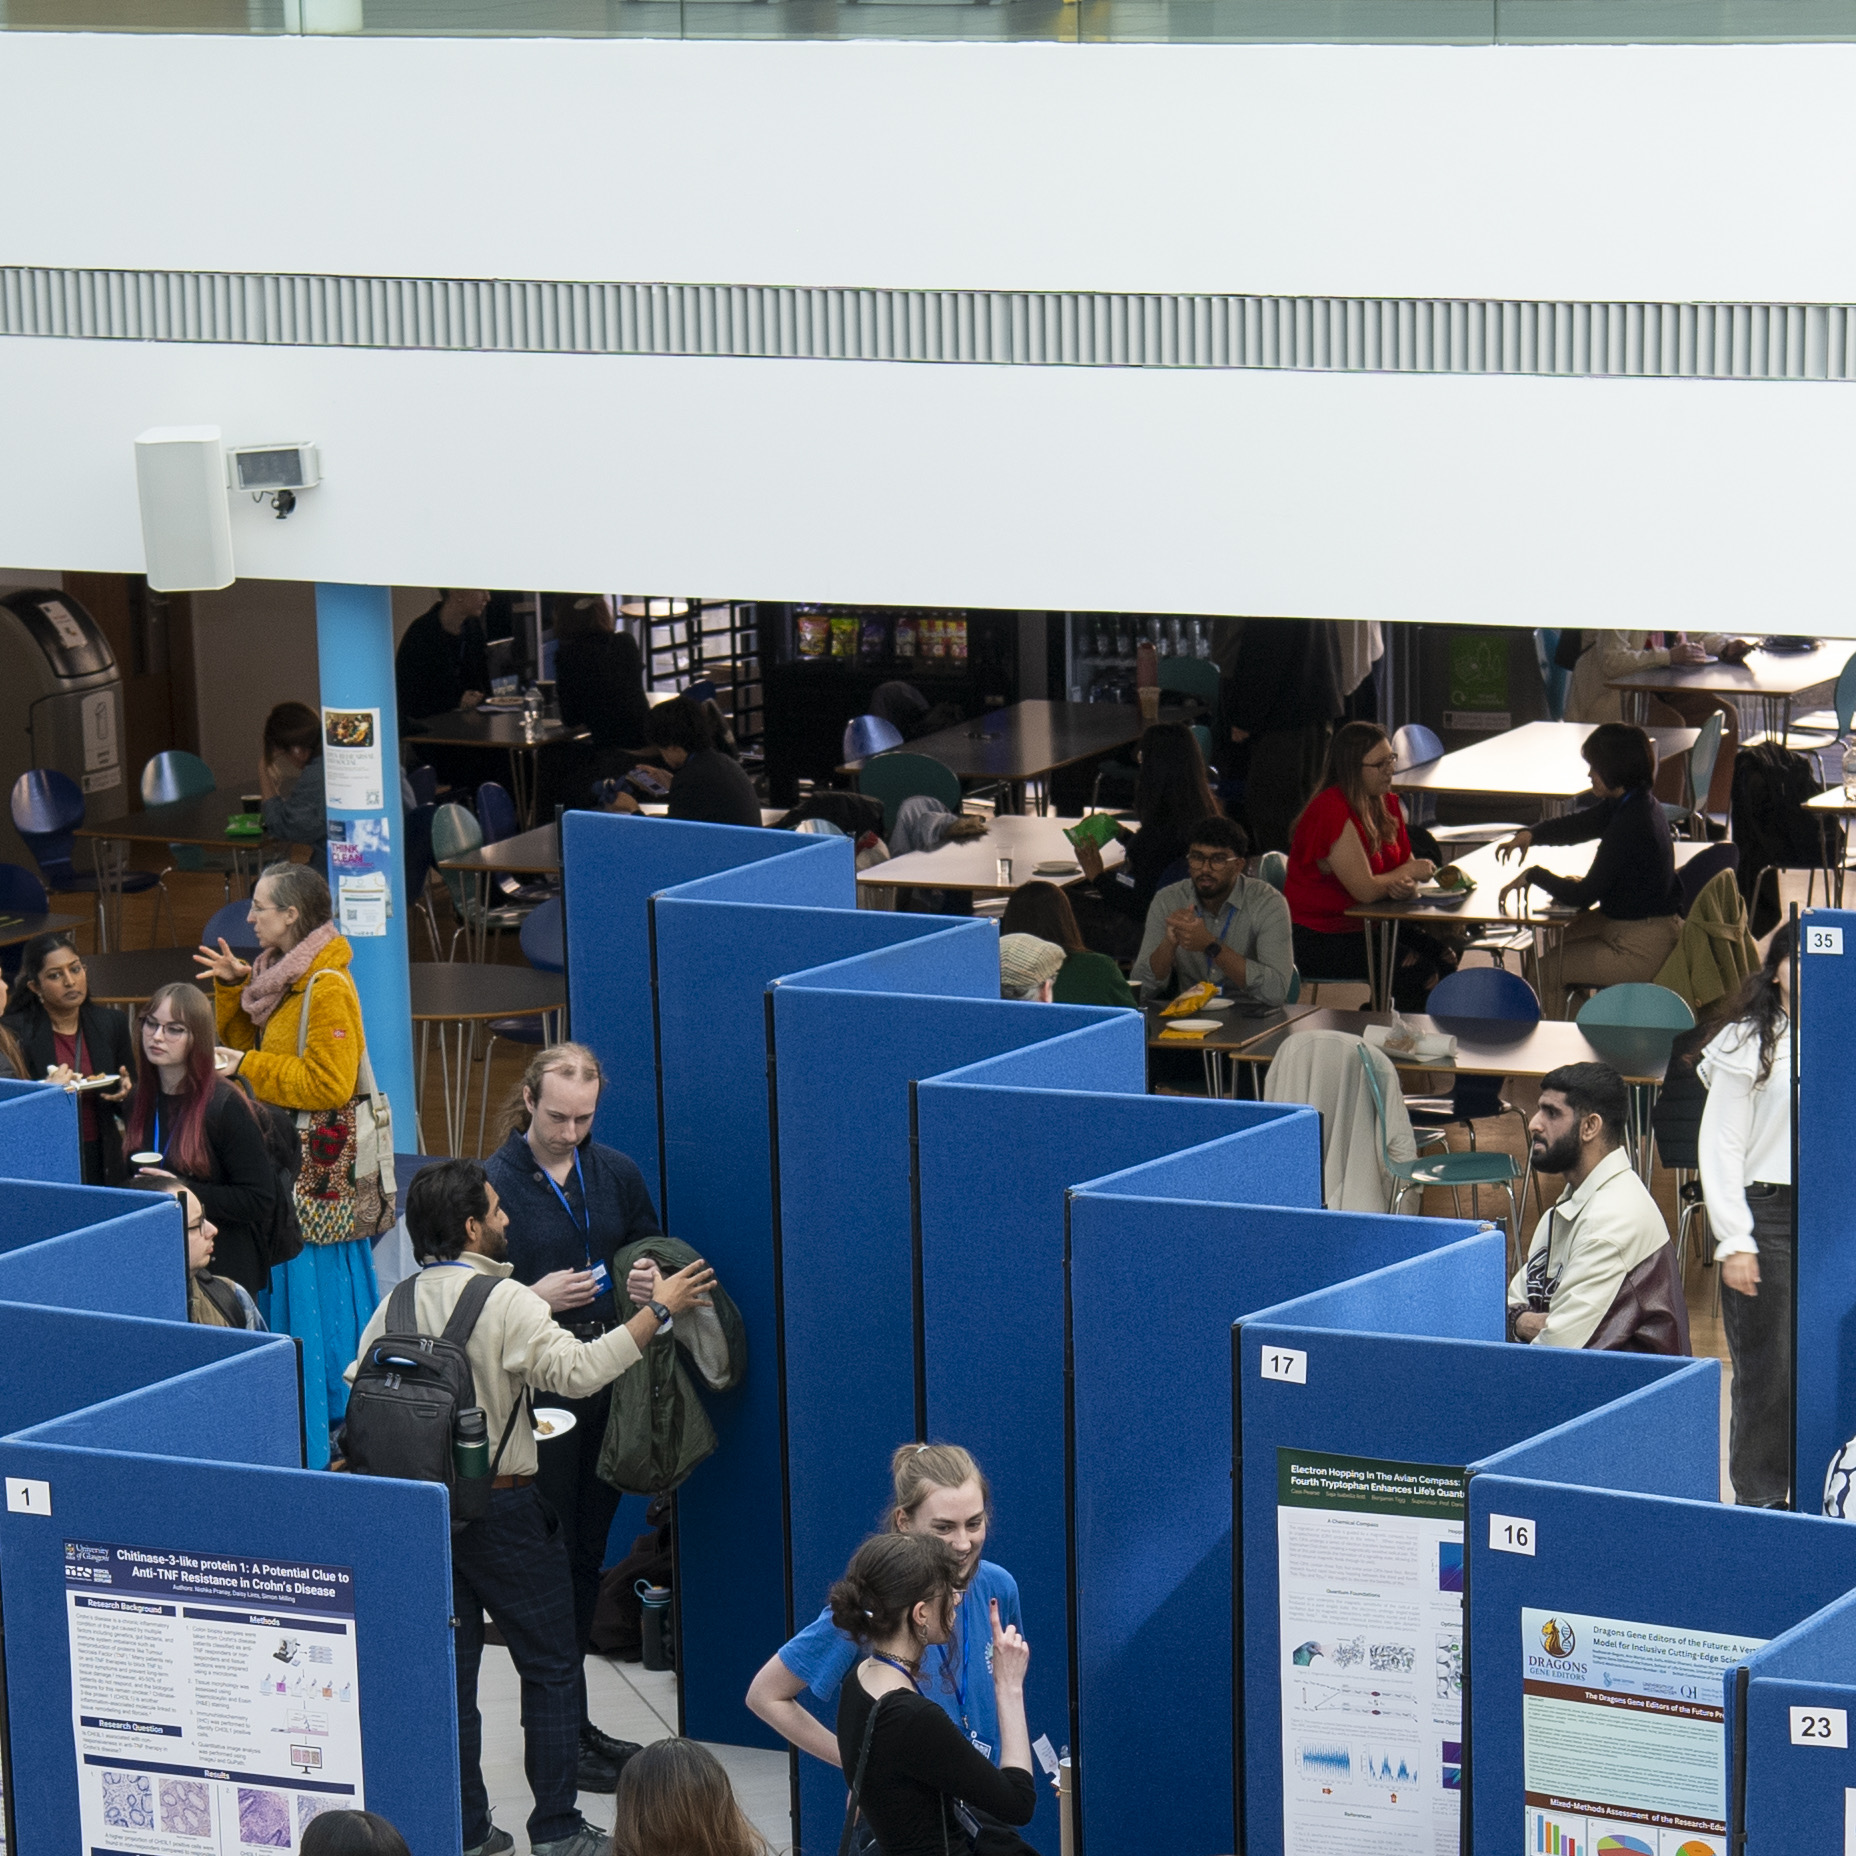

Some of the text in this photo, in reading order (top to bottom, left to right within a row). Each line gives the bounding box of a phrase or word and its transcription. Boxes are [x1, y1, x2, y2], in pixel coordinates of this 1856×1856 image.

[331, 842, 359, 854] THINK
[332, 852, 363, 863] CLEAN
[1814, 932, 1834, 948] 35
[1271, 1356, 1294, 1375] 17
[1290, 1464, 1461, 1489] Electron Hopping In The Avian Compass:
[1290, 1476, 1435, 1496] Fourth Tryptophan Enhances Life's
[21, 1488, 30, 1506] 1
[1503, 1526, 1528, 1546] 16
[116, 1549, 350, 1583] Chitinase-3-like protein 1: A Potential Clue to
[131, 1566, 179, 1581] Anti-TNF
[180, 1570, 238, 1588] Resistance
[240, 1575, 250, 1588] in
[252, 1577, 293, 1593] Crohn's
[294, 1582, 336, 1598] Disease
[87, 1598, 163, 1615] Research Background
[249, 1615, 281, 1627] Methods
[1593, 1625, 1739, 1652] Dragons Gene Editors of the Future: A
[1593, 1637, 1719, 1664] Model for Inclusive Cutting-Edge
[1528, 1655, 1588, 1674] DRAGONS
[1529, 1667, 1586, 1682] GENE EDITORS
[98, 1719, 164, 1734] Research Question
[1801, 1717, 1832, 1738] 23
